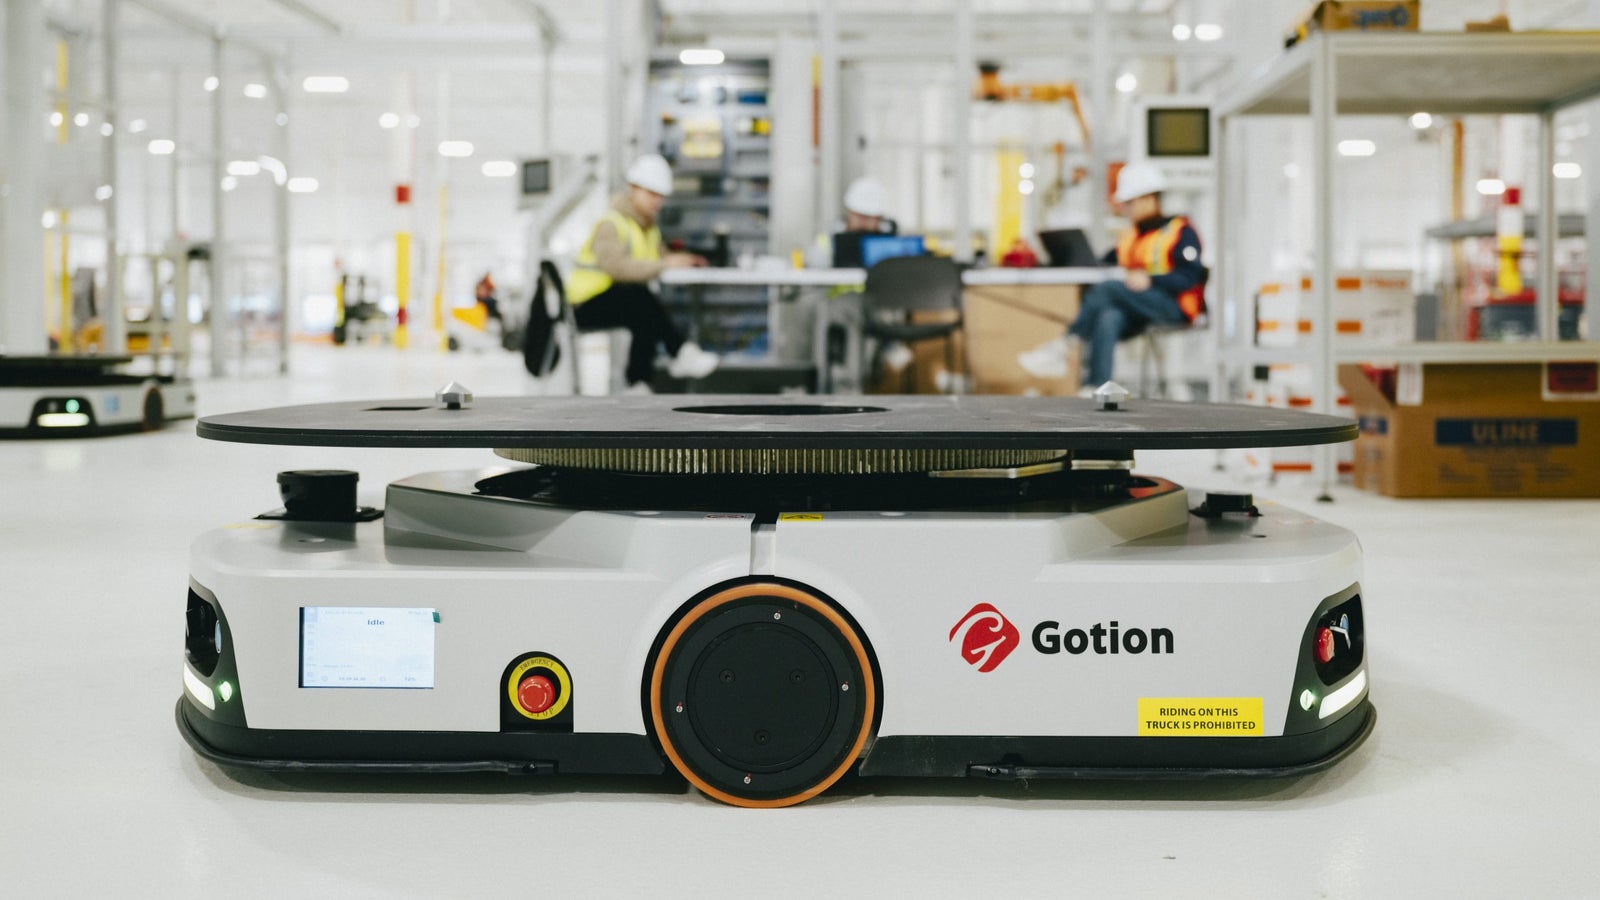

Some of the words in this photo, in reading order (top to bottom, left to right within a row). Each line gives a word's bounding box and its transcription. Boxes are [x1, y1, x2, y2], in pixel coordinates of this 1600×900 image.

[1031, 620, 1174, 655] Gotion
[520, 659, 553, 671] EMERGENCY
[1159, 707, 1196, 717] RIDING
[1198, 707, 1214, 717] ON
[1215, 707, 1239, 717] THIS
[1146, 720, 1180, 730] TRUCK
[1182, 720, 1192, 730] IS
[1193, 720, 1256, 730] PROHIBITED
